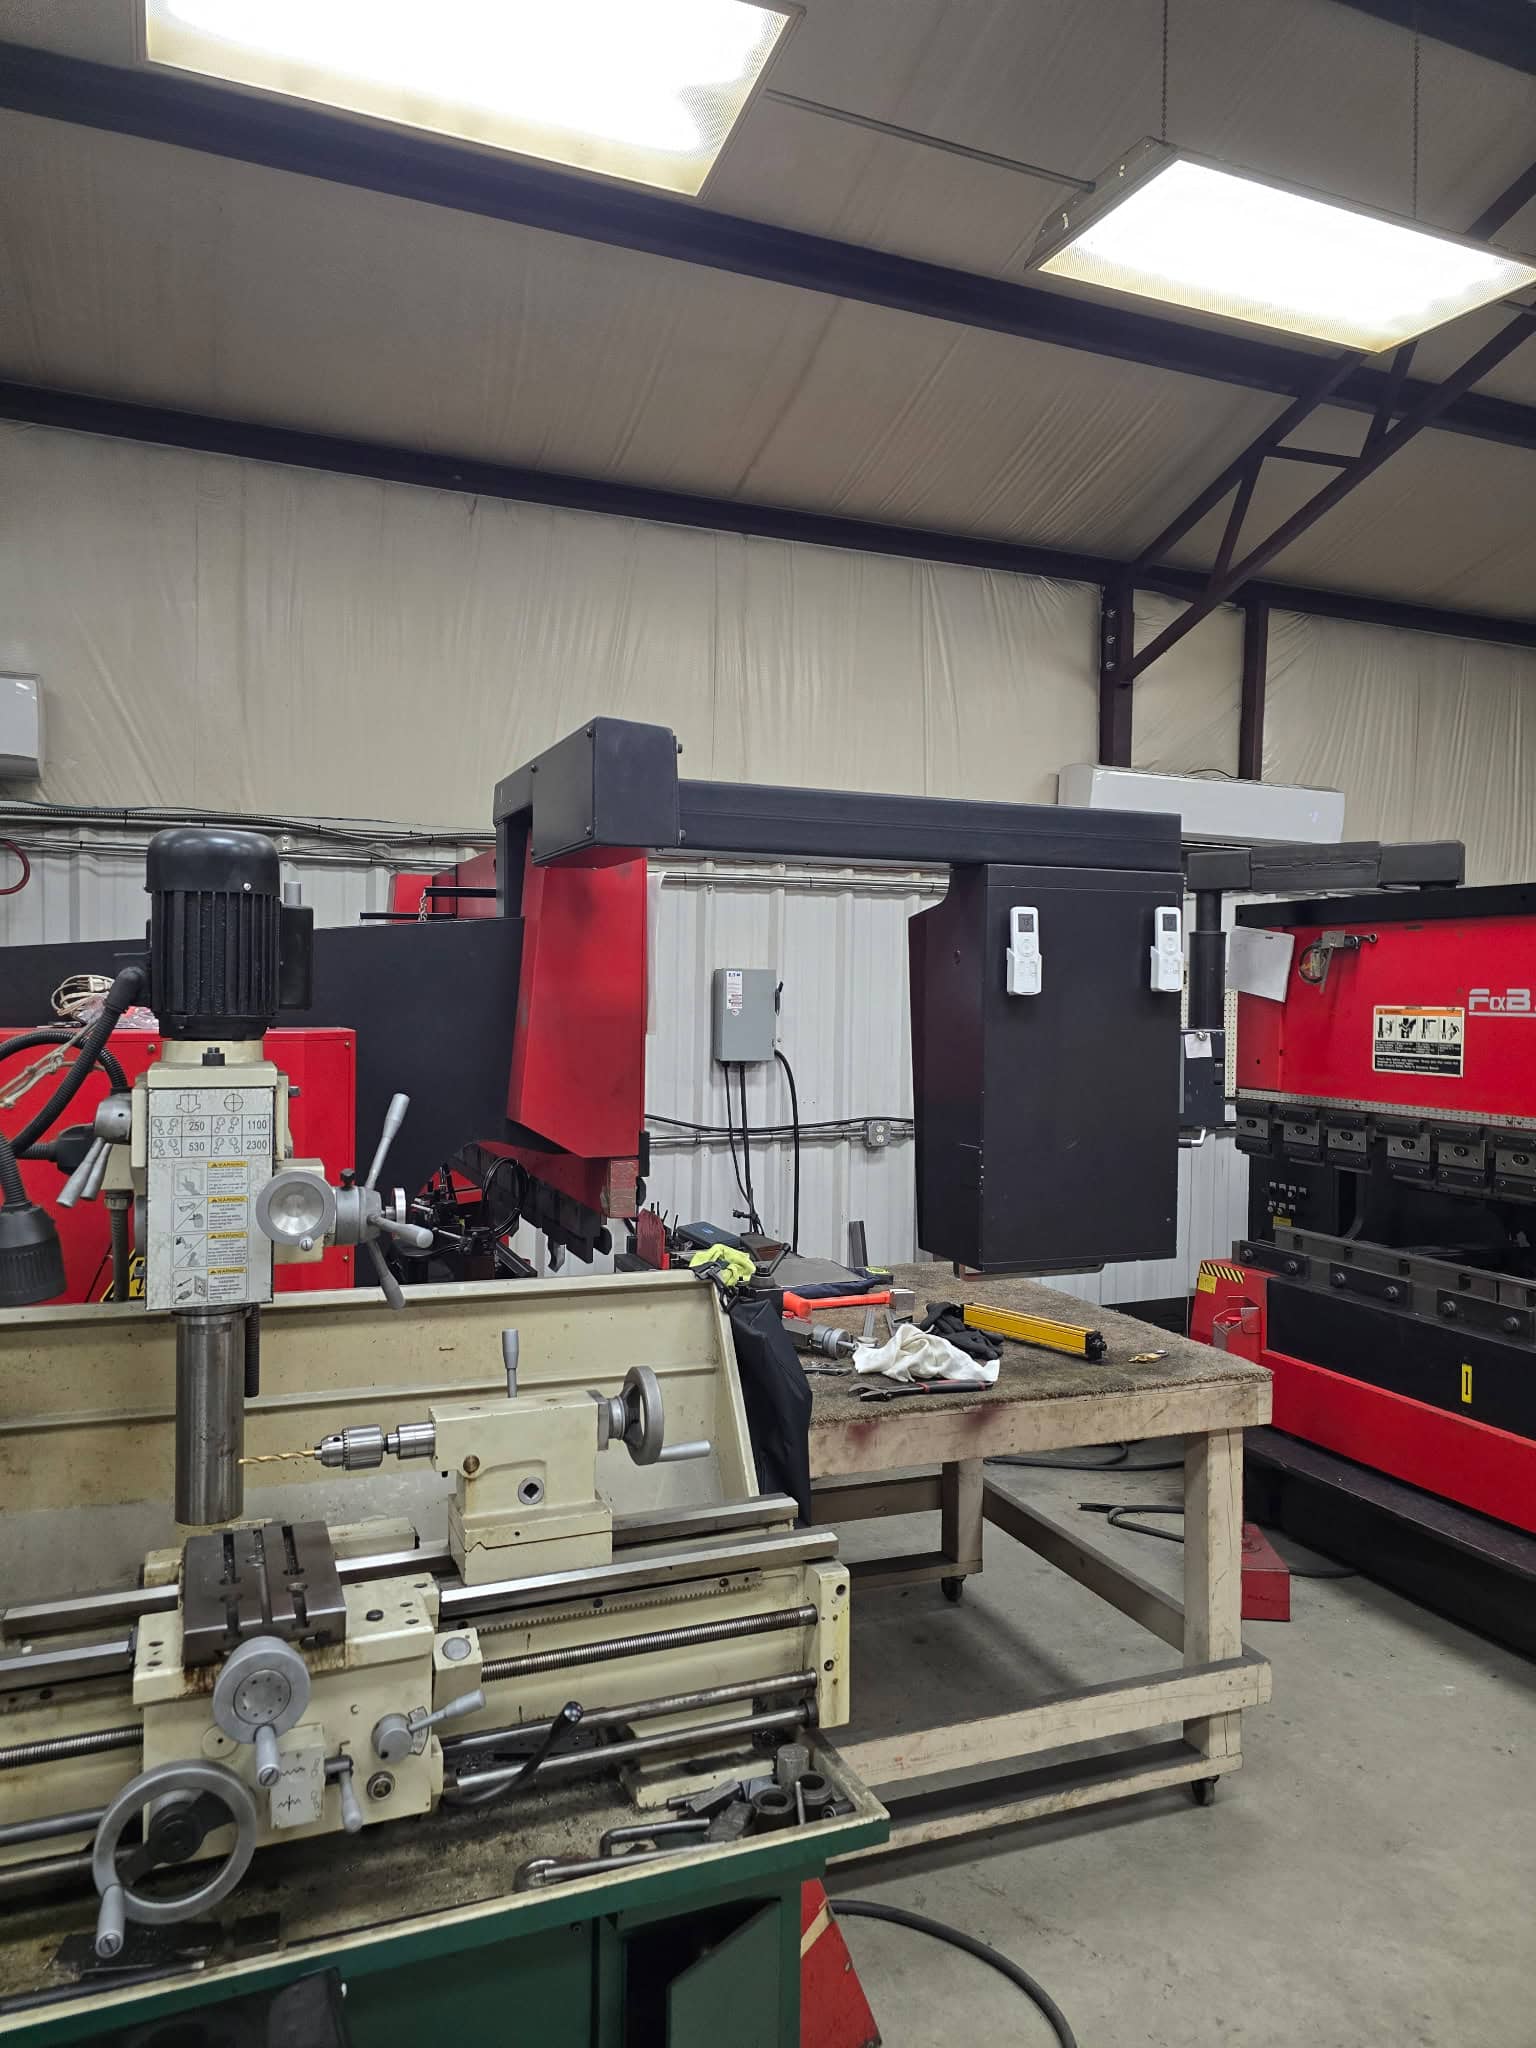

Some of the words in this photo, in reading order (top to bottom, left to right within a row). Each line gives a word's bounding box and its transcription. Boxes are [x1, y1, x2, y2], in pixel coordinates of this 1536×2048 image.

[188, 1121, 205, 1131] 250
[247, 1119, 267, 1130] 1100
[188, 1141, 205, 1151] 530
[246, 1139, 267, 1150] 2300
